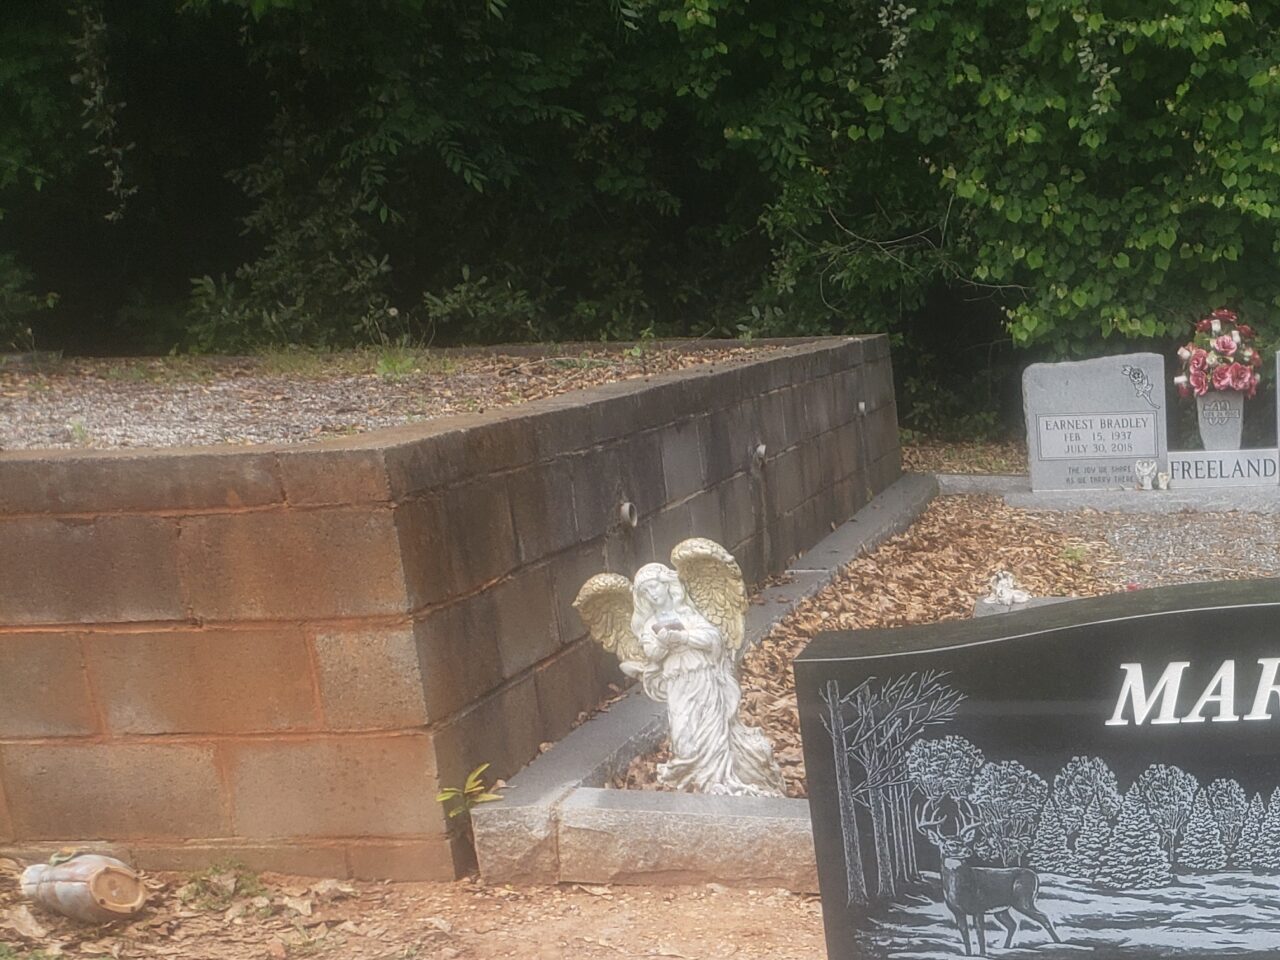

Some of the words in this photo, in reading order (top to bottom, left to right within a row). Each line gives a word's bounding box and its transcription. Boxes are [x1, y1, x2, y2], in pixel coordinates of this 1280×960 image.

[1045, 419, 1094, 430] EARNEST
[1100, 417, 1148, 429] BRADLEY
[1111, 431, 1132, 441] 1937
[1064, 445, 1088, 454] JULY
[1093, 443, 1107, 453] 30,
[1111, 443, 1133, 453] 2018
[1170, 459, 1277, 480] FREELAND
